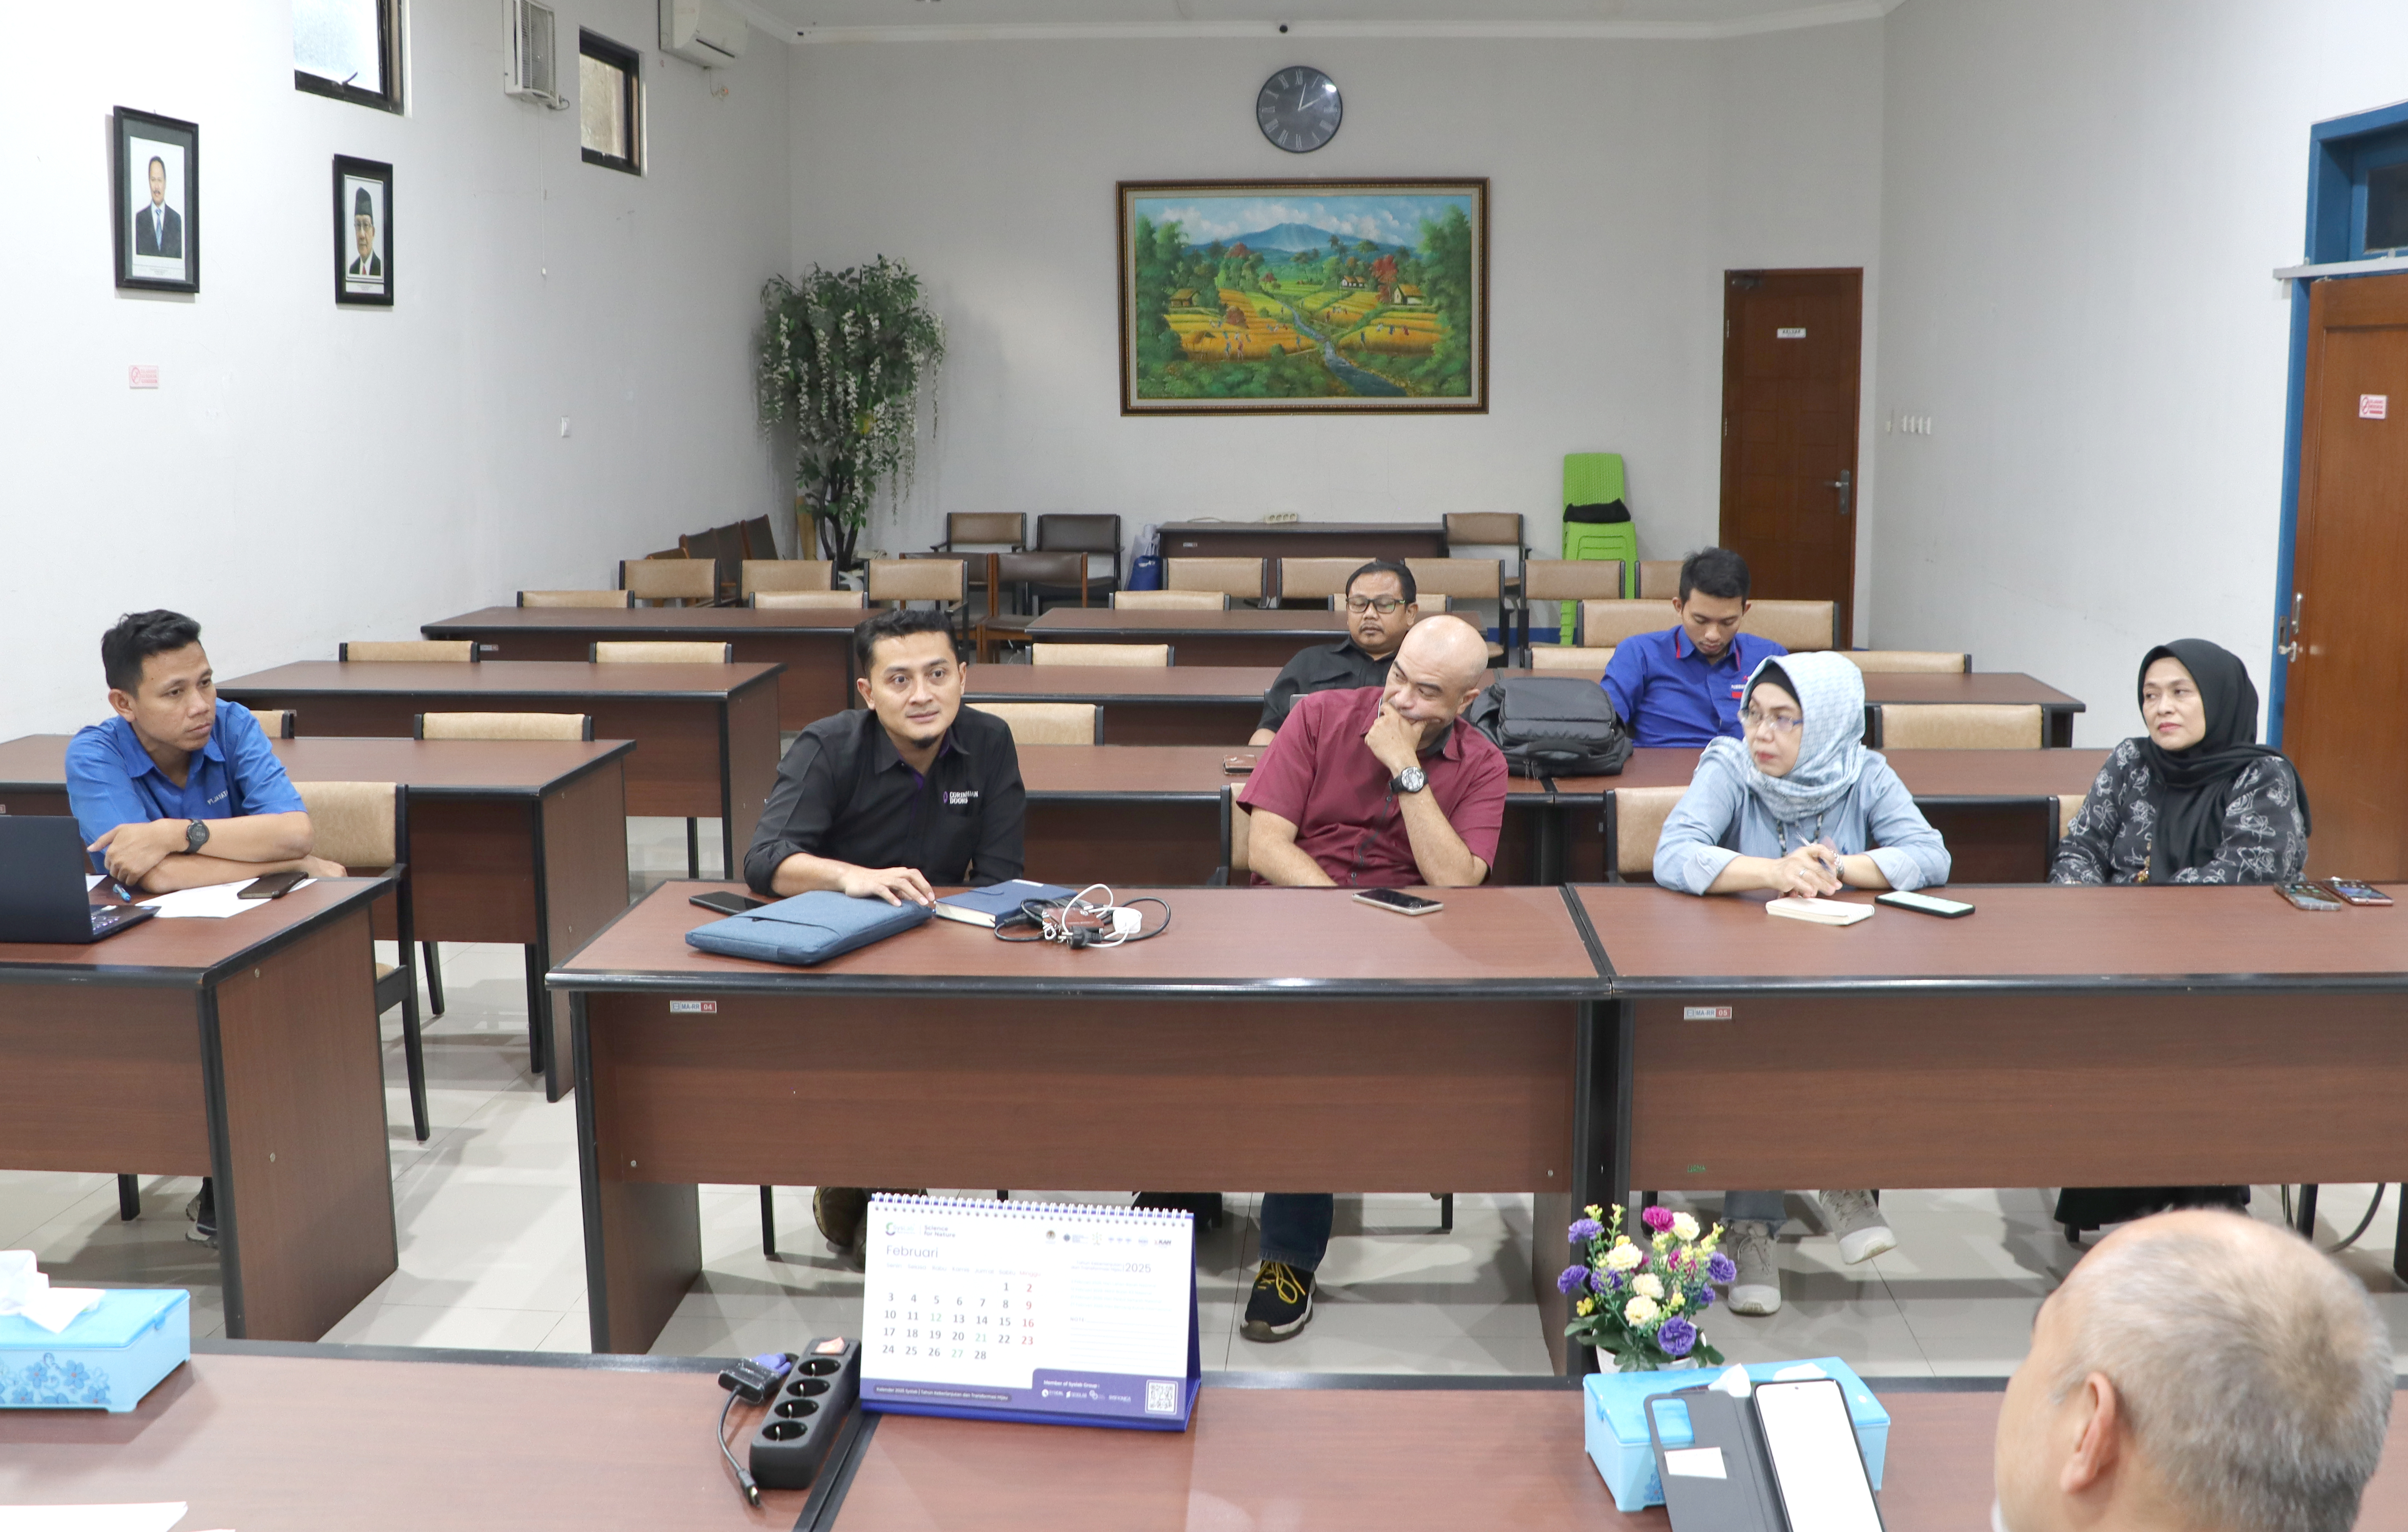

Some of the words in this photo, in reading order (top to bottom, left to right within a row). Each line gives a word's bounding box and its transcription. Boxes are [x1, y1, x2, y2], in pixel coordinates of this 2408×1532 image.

[887, 1245, 938, 1258] Februari
[1126, 1263, 1151, 1273] 2025
[1005, 1283, 1009, 1292] 1
[1027, 1284, 1032, 1293] 2
[890, 1293, 894, 1302] 3
[911, 1295, 917, 1303] 4
[935, 1296, 940, 1305] 5
[957, 1297, 963, 1306] 6
[981, 1299, 986, 1307] 7
[1003, 1300, 1009, 1309] 8
[1027, 1302, 1032, 1310] 9
[886, 1310, 897, 1319] 10
[908, 1312, 918, 1321] 11
[931, 1313, 942, 1322] 12
[954, 1315, 965, 1323] 13
[977, 1316, 988, 1325] 14
[1000, 1317, 1011, 1327] 15
[1024, 1319, 1034, 1328] 16
[885, 1328, 895, 1336] 17
[908, 1329, 918, 1338] 18
[931, 1331, 942, 1339] 19
[953, 1332, 965, 1341] 20
[976, 1333, 986, 1343] 21
[999, 1335, 1010, 1344] 22
[1022, 1337, 1034, 1345] 23
[883, 1345, 894, 1354] 24
[906, 1346, 918, 1355] 25
[929, 1348, 941, 1357] 26
[952, 1349, 964, 1358] 27
[975, 1351, 986, 1360] 28
